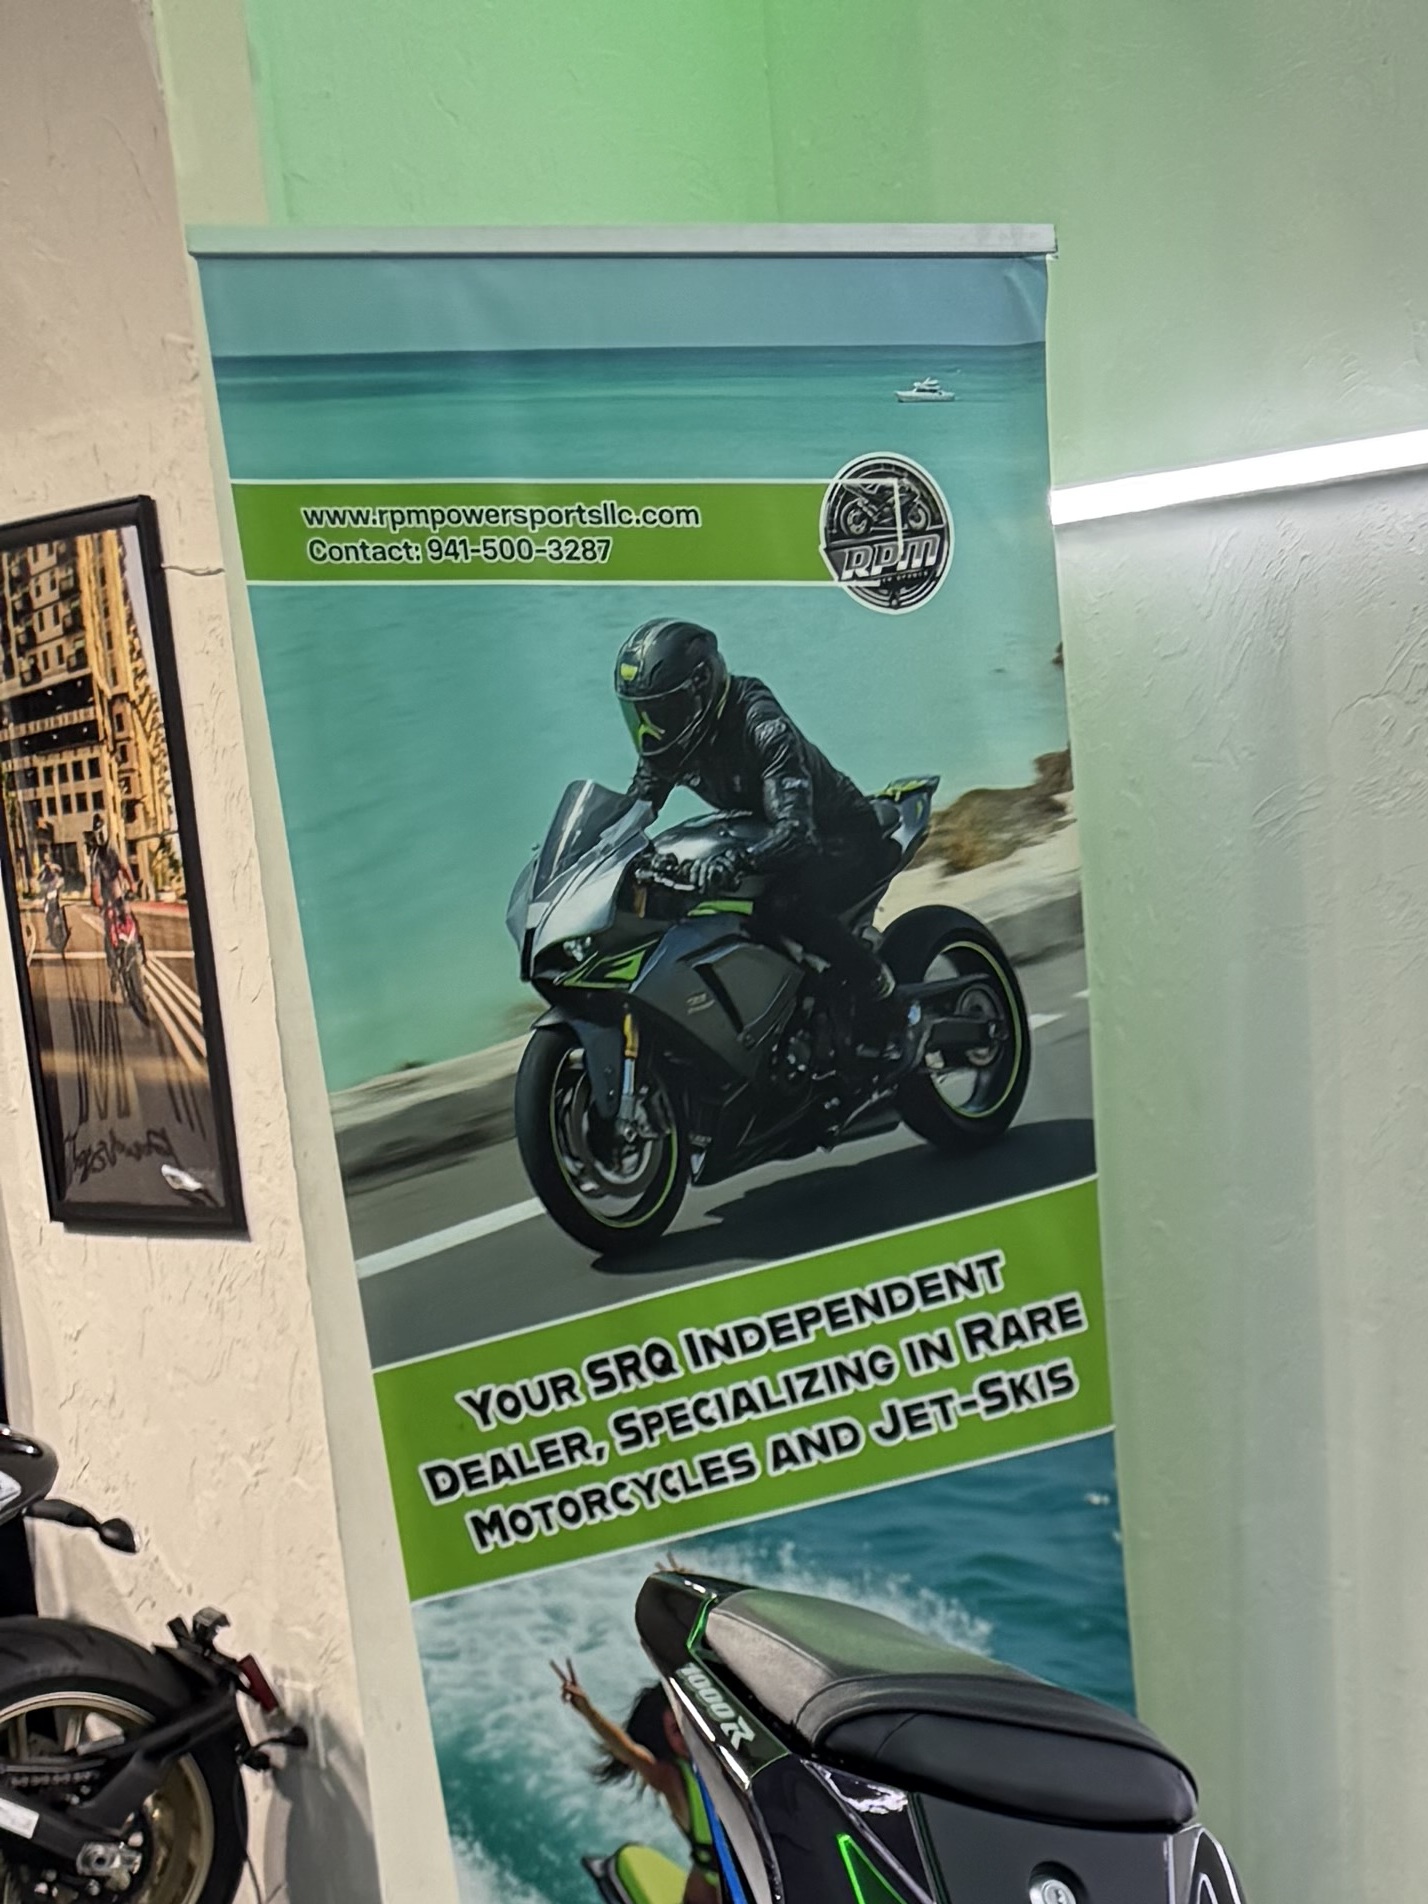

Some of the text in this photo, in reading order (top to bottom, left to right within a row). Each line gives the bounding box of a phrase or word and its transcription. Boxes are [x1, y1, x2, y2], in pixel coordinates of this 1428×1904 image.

[301, 501, 700, 533] www.rpmpowersportsllc.com
[307, 536, 612, 564] Contact: 941-500-3287
[841, 534, 940, 580] RPM
[584, 1338, 679, 1399] SRQ
